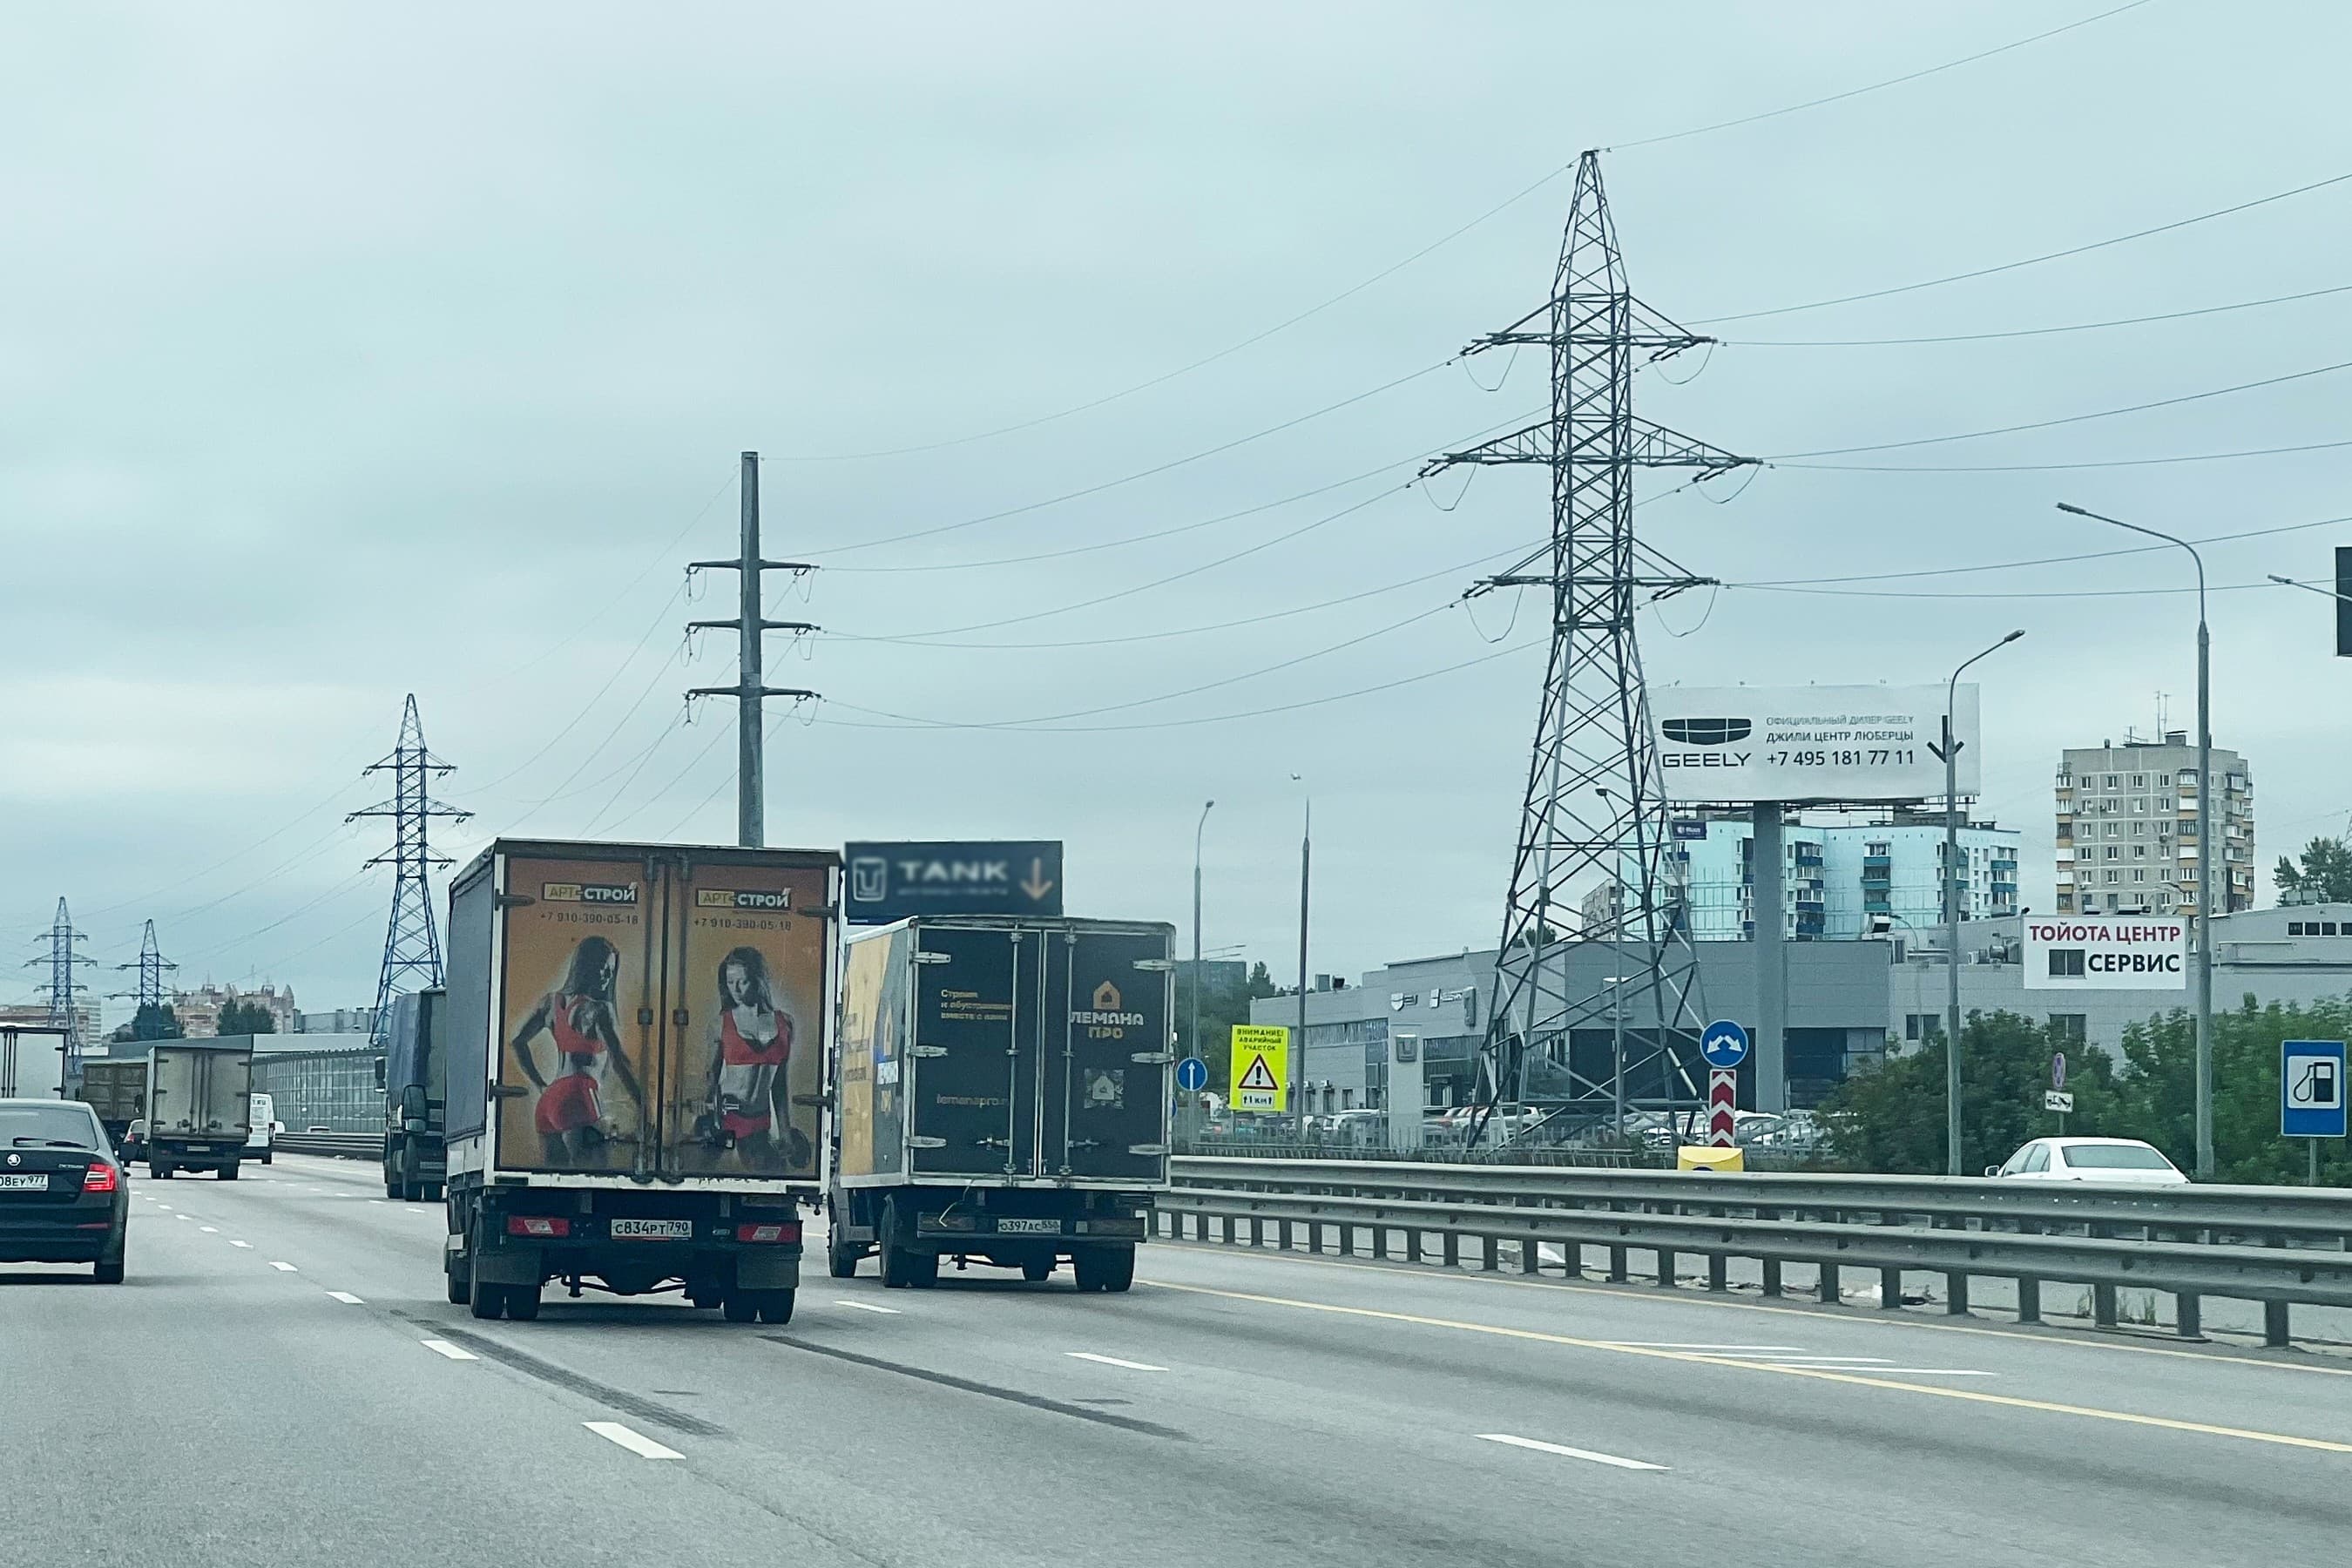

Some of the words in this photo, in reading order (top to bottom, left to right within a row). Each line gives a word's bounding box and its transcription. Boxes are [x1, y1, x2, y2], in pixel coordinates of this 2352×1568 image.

[1767, 732, 1811, 744] ДЖИЛИ
[1815, 732, 1851, 743] ЦЕНТР
[1854, 731, 1914, 742] ЛЮБЕРЦЫ
[1662, 753, 1752, 767] GEELY
[1767, 751, 1788, 766] +7
[1793, 751, 1825, 766] 495
[1832, 750, 1861, 765] 181
[1868, 750, 1889, 765] 77
[1896, 750, 1914, 765] 11
[898, 861, 1008, 882] TANK
[2029, 922, 2111, 941] ТОЙОТА
[2116, 926, 2180, 945] ЦЕНТР
[2088, 954, 2180, 972] СЕРВИС
[1071, 1011, 1144, 1025] ЛЕМАНА
[1089, 1026, 1124, 1038] ПРО
